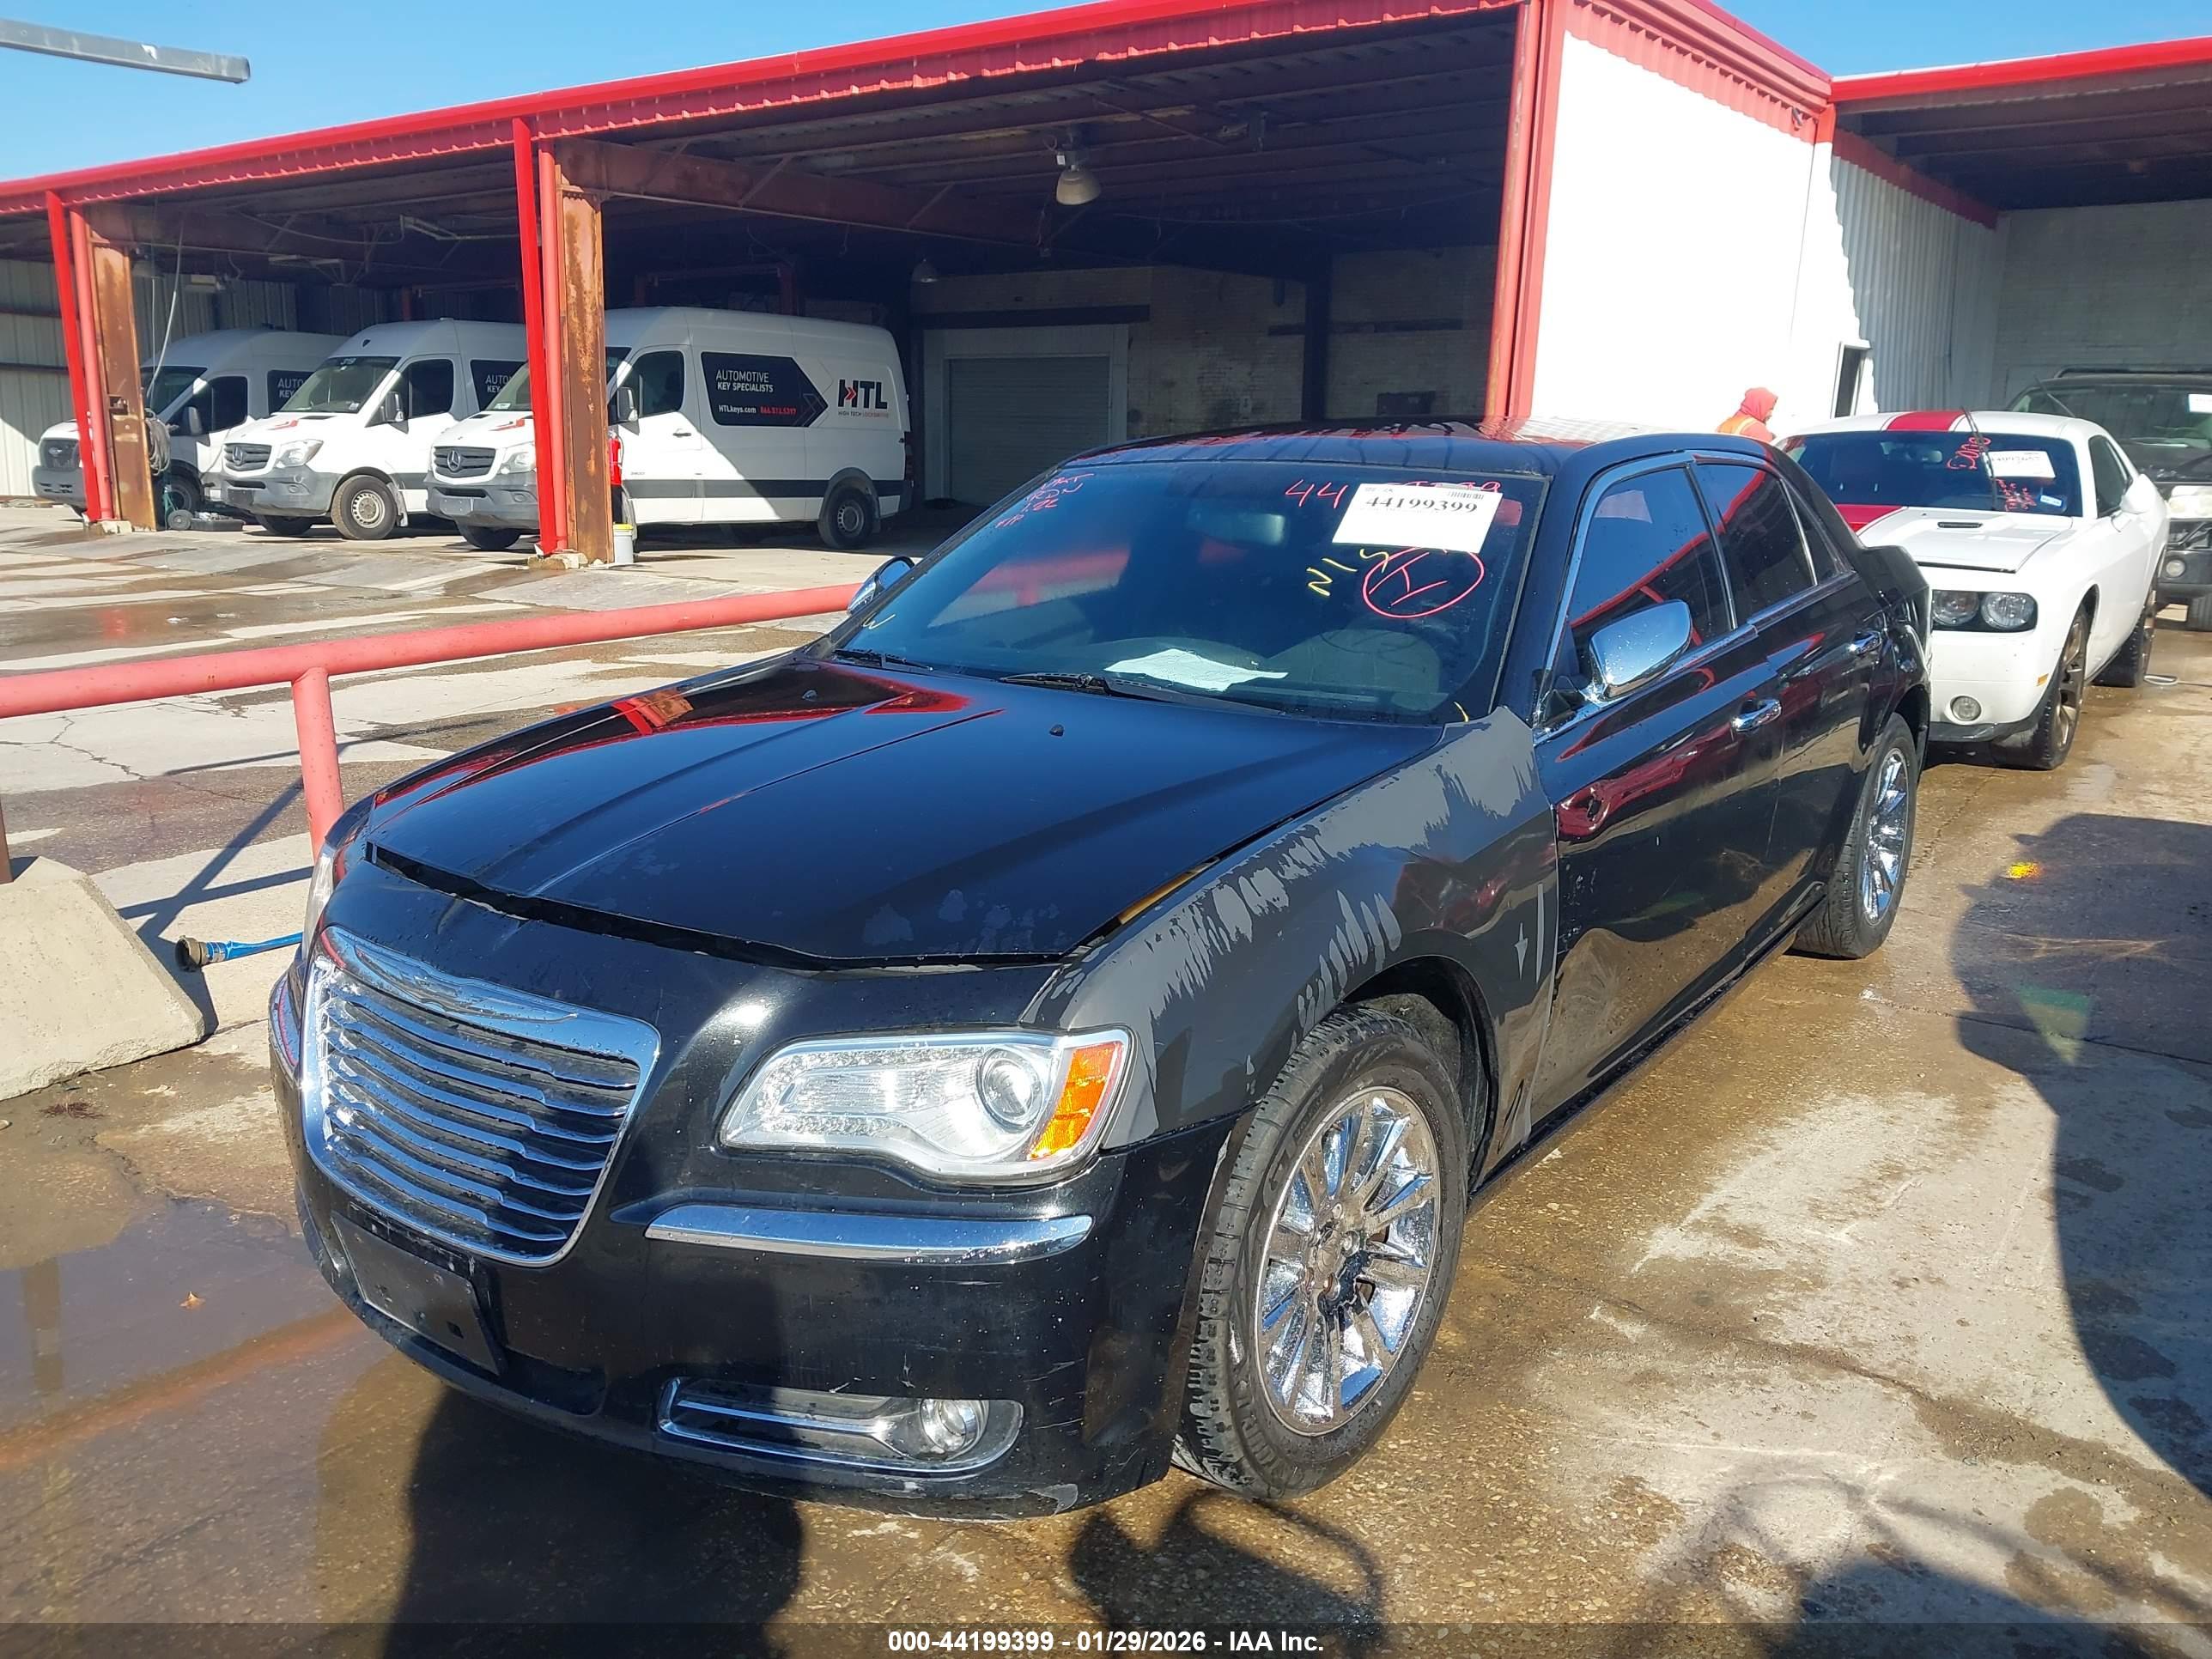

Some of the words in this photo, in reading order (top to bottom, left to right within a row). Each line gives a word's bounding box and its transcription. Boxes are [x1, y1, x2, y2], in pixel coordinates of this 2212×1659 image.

[715, 369, 769, 383] AUTOMOTIVE
[487, 384, 501, 393] KEY
[717, 381, 731, 391] KEY
[732, 383, 774, 392] SPECIALISTS
[838, 379, 888, 410] HTL
[719, 404, 757, 415] HTLkeys.com
[1365, 495, 1479, 514] 44199399
